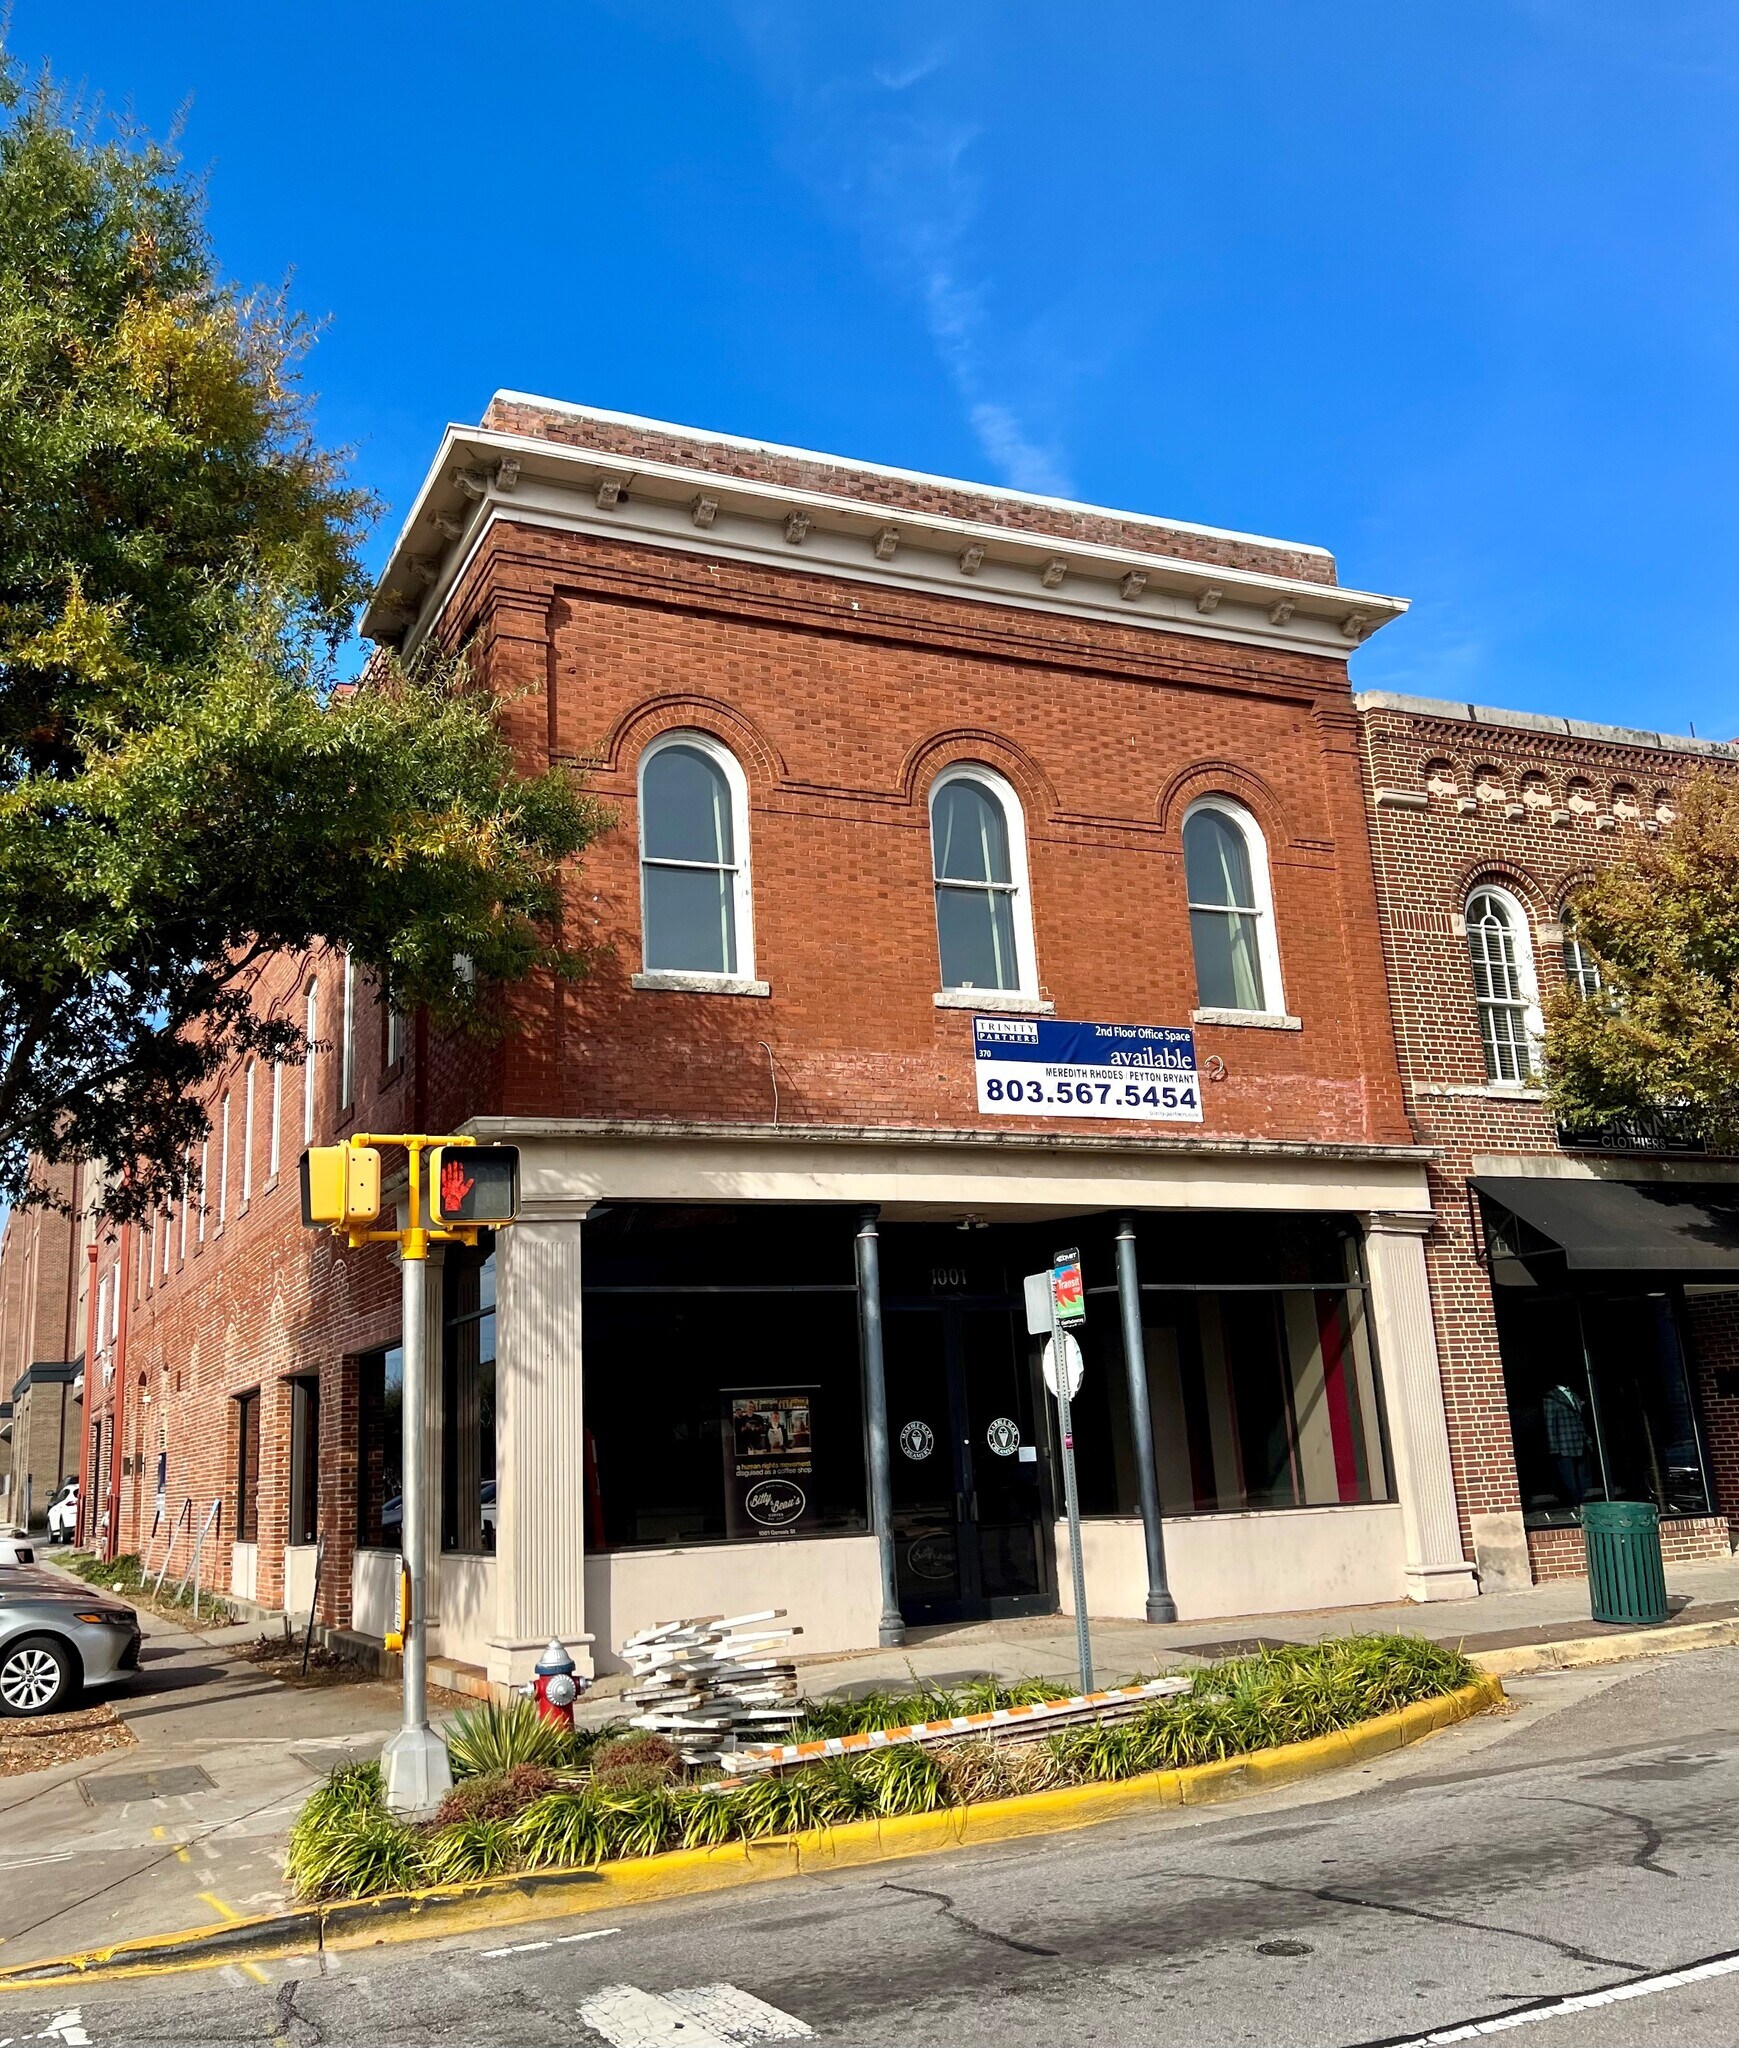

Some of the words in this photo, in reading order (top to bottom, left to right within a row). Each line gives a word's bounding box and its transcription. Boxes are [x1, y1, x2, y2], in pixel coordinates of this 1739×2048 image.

[979, 1022, 1035, 1033] TRINITY
[1095, 1026, 1112, 1037] 2nd
[1114, 1026, 1136, 1038] Floor
[1138, 1028, 1164, 1040] Office
[1165, 1030, 1191, 1042] Space
[979, 1033, 1037, 1043] PARTNERS
[979, 1049, 991, 1058] 370
[1110, 1046, 1192, 1069] available
[1045, 1067, 1088, 1079] MEREDITH
[1090, 1069, 1123, 1080] RHODES
[1130, 1071, 1161, 1082] PEYTON
[1163, 1073, 1195, 1084] BRYANT
[986, 1078, 1197, 1109] 803.567.5454
[1601, 1136, 1666, 1150] CLOTHIERS
[930, 1268, 967, 1285] 1001
[1058, 1277, 1080, 1290] Transit
[736, 1469, 764, 1478] disguised
[797, 1466, 813, 1474] shop
[762, 1462, 779, 1470] rights
[780, 1460, 811, 1468] movement
[750, 1492, 772, 1508] Bitty
